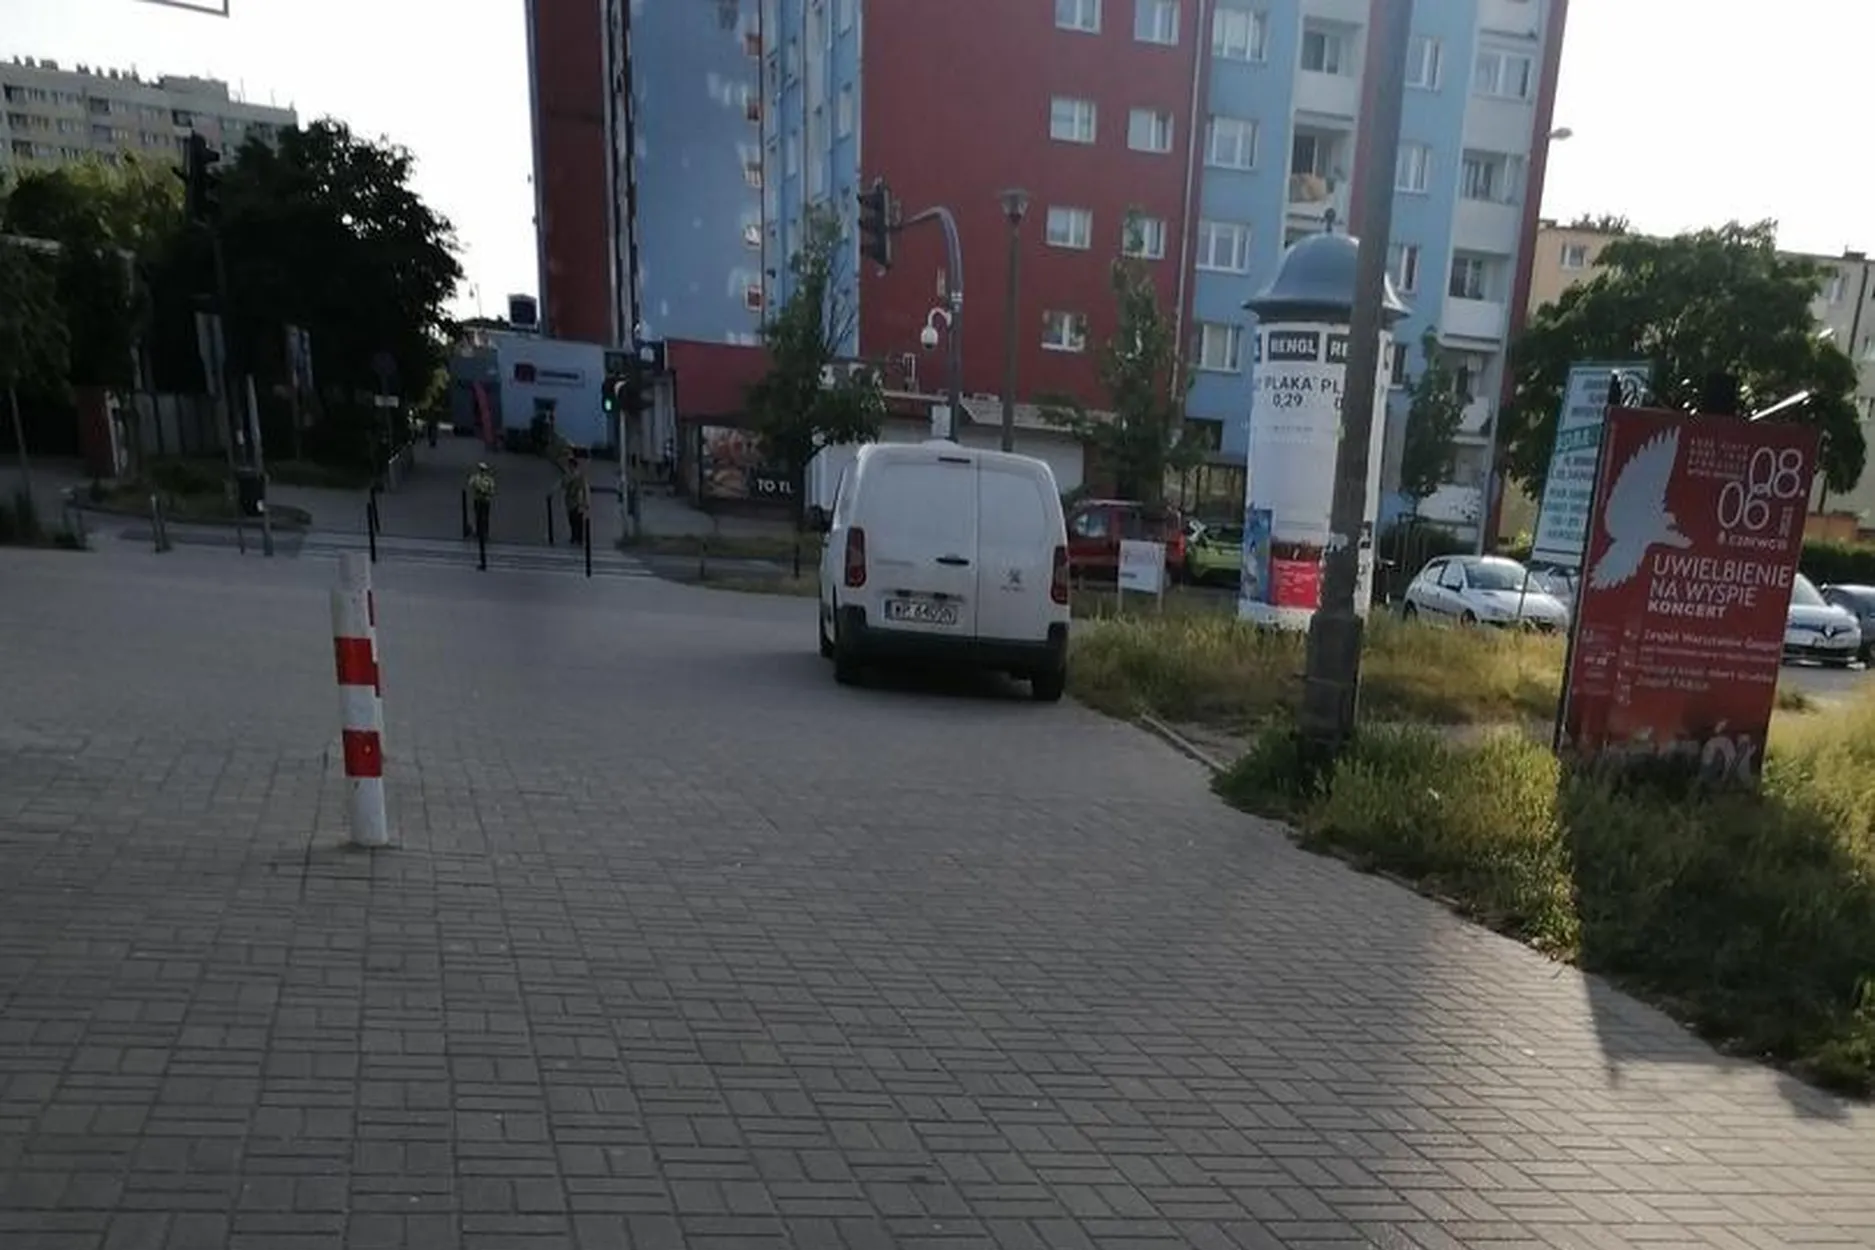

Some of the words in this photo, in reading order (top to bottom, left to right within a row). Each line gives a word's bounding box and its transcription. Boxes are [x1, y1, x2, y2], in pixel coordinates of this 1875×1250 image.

[757, 478, 776, 493] TO
[1717, 480, 1770, 530] 06
[1653, 553, 1792, 588] UWIELBIENIE
[1650, 578, 1678, 599] NA
[1686, 581, 1758, 607] WYSPIE
[1647, 599, 1728, 618] KONCERT
